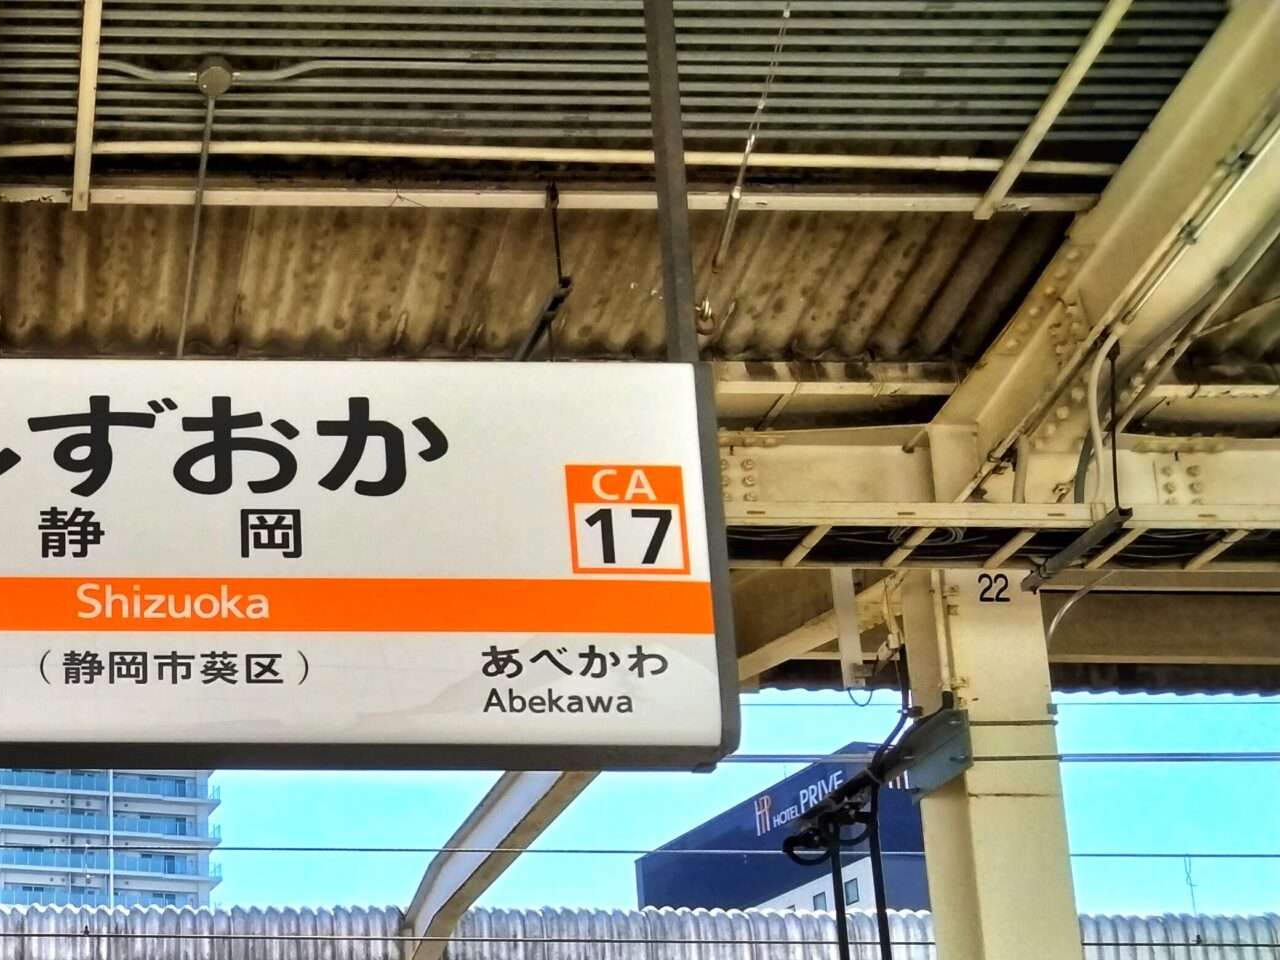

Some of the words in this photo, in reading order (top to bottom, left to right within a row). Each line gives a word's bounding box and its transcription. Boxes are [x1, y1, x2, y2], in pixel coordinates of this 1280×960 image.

[592, 468, 657, 501] CA
[39, 508, 303, 559] 静岡
[584, 508, 673, 565] 17
[76, 583, 270, 619] Shizuoka
[977, 573, 1011, 602] 22
[481, 645, 669, 681] あべかわ
[483, 688, 634, 715] Abekawa
[773, 804, 801, 828] HOTEL
